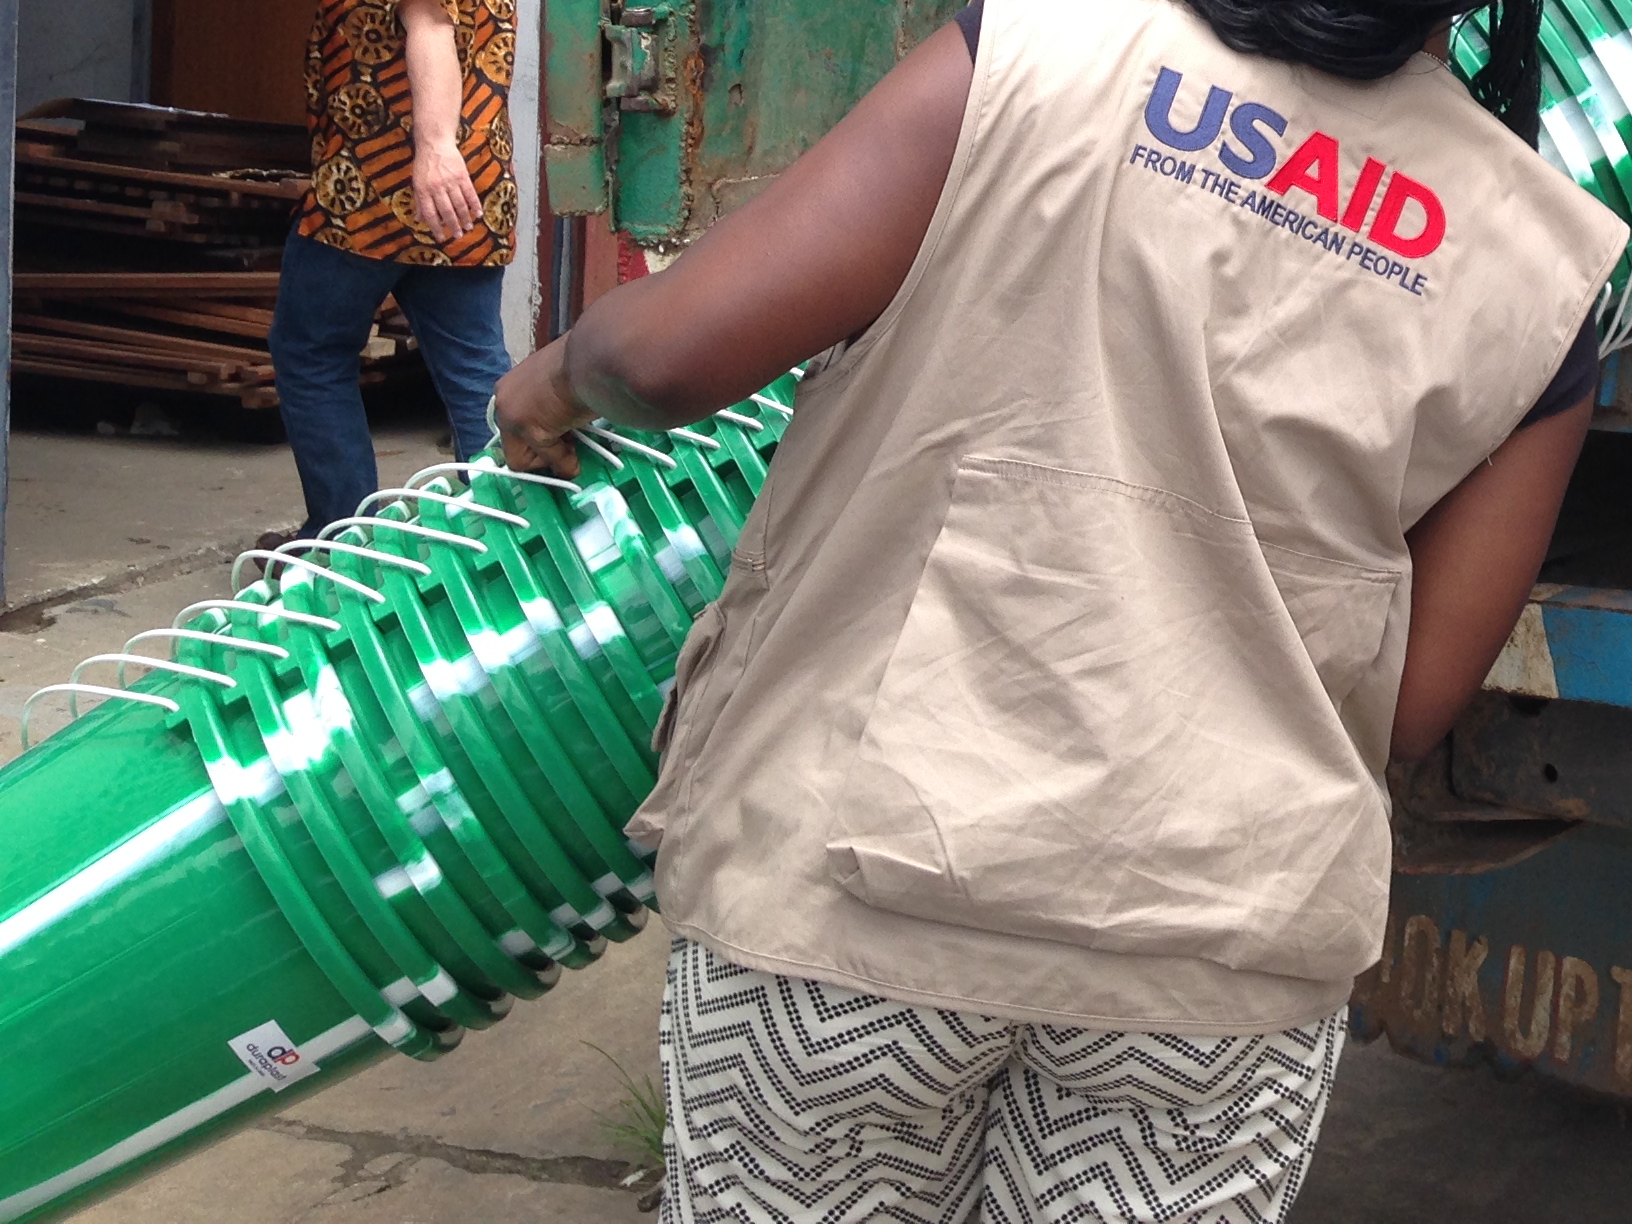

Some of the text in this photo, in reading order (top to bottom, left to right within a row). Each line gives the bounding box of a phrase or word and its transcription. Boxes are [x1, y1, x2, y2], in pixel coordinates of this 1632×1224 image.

[1130, 143, 1428, 296] FROM THE AMERICAN PEOPLE
[1144, 66, 1446, 258] USAID
[246, 1043, 287, 1080] duraplast
[1382, 914, 1489, 1042] OK
[1503, 944, 1599, 1062] UP
